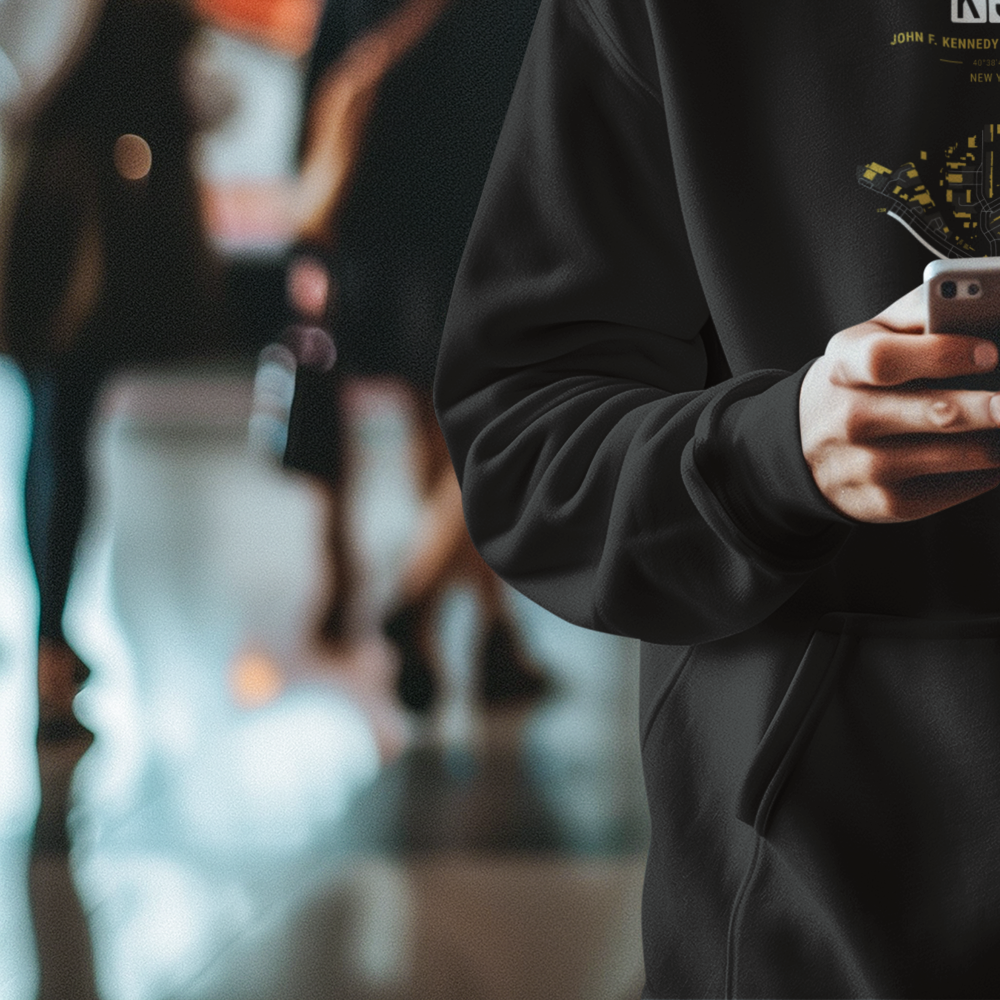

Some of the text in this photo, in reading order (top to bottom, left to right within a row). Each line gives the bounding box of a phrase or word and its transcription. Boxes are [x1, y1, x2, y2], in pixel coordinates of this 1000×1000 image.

[890, 31, 924, 46] JOHN
[928, 33, 938, 46] F.
[942, 36, 999, 50] KENNEDY
[970, 73, 993, 83] NEW
